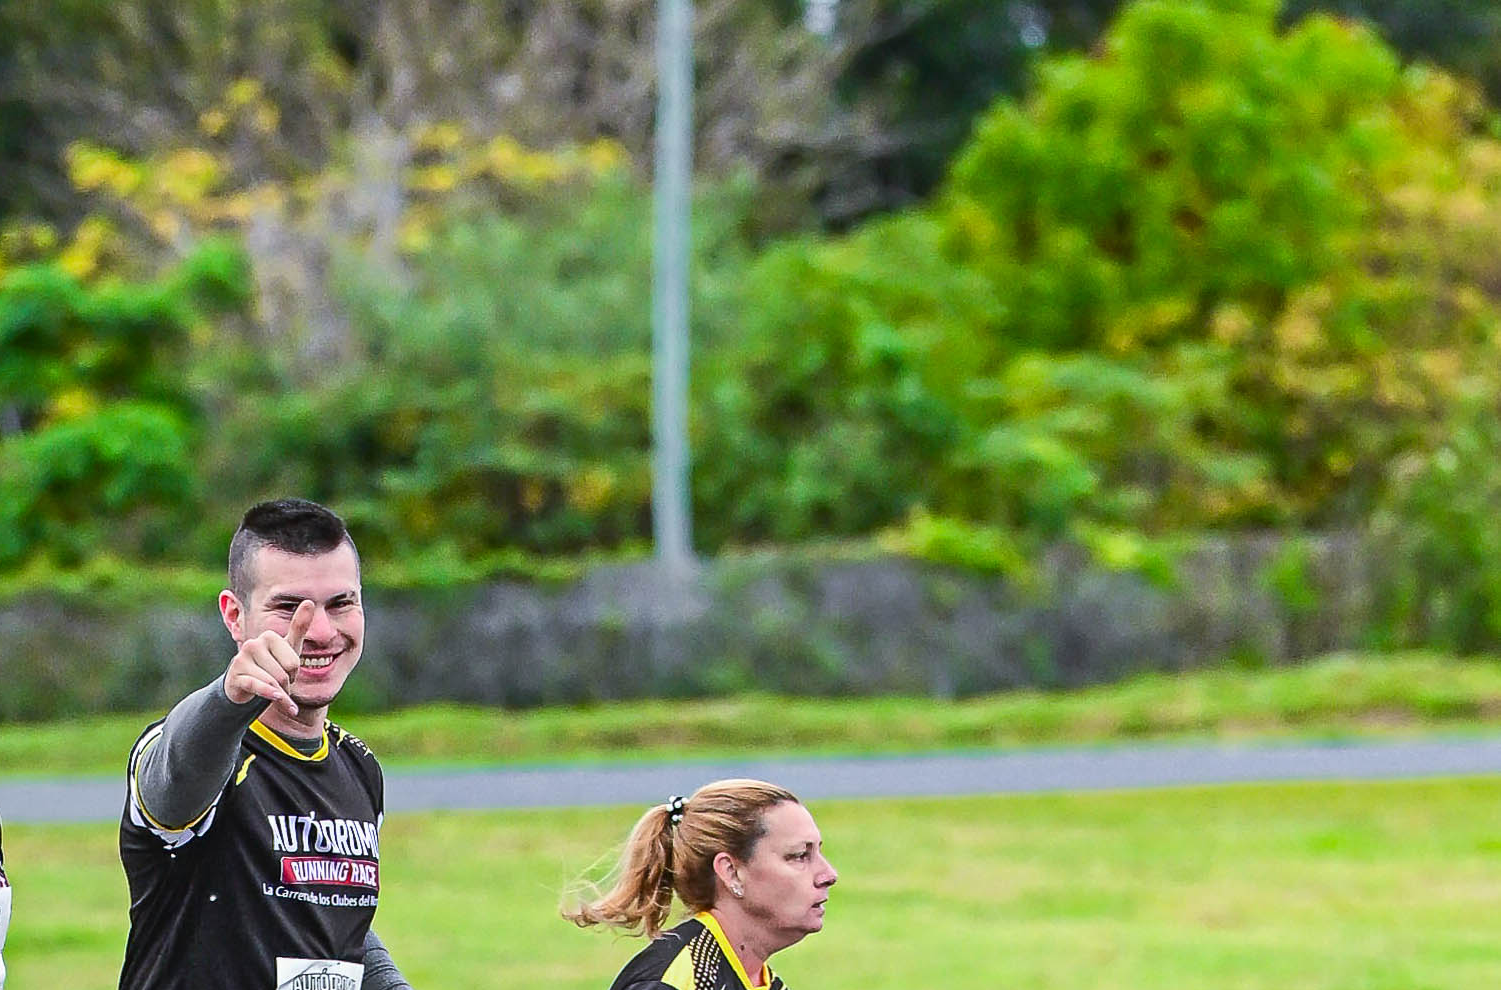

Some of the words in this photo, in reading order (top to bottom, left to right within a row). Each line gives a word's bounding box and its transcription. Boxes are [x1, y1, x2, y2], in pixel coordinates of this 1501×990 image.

[291, 861, 349, 882] RUNNING
[350, 862, 377, 887] RACE
[262, 883, 274, 896] La
[319, 893, 331, 905] los
